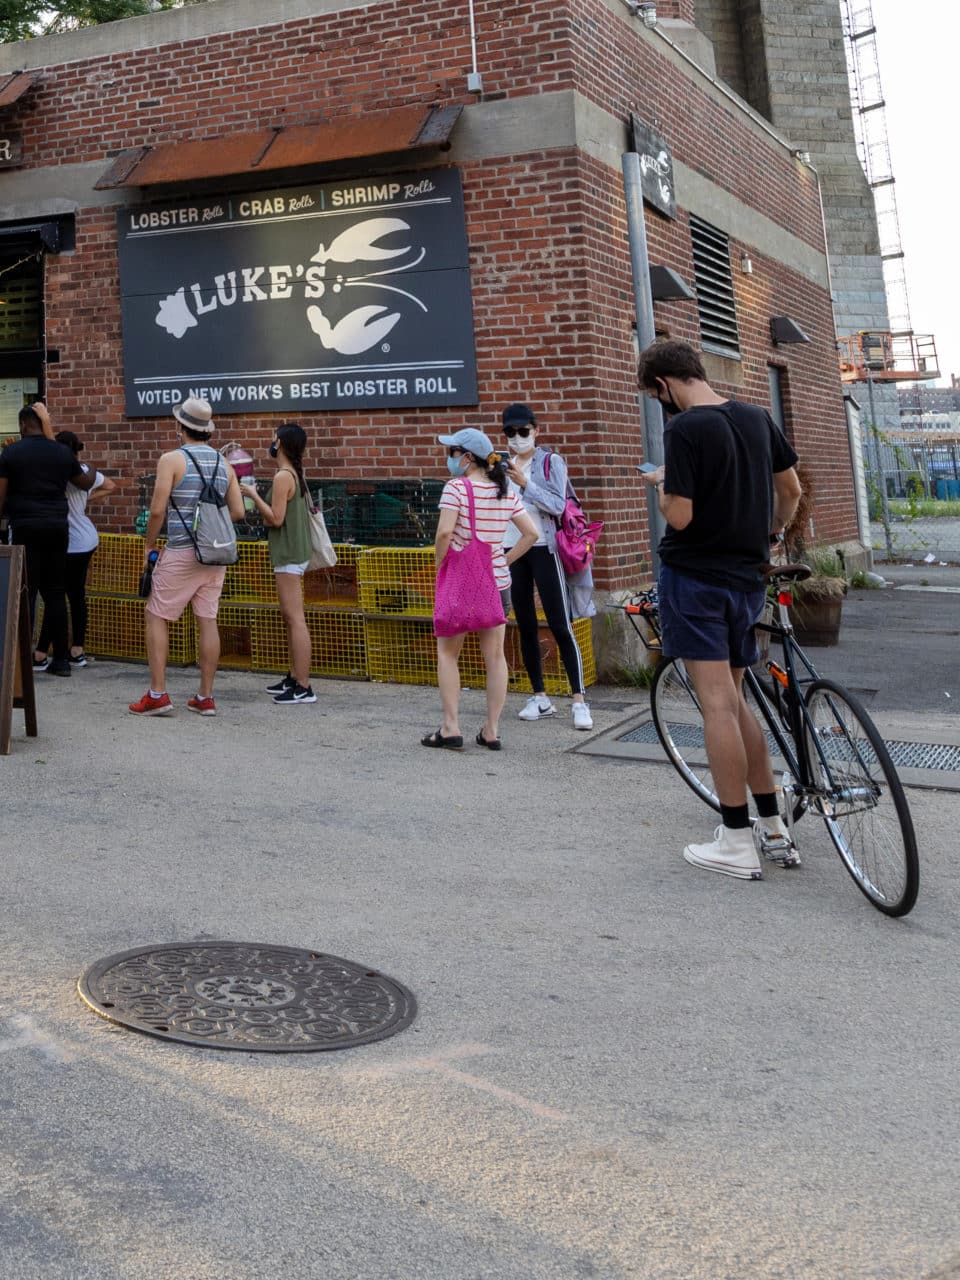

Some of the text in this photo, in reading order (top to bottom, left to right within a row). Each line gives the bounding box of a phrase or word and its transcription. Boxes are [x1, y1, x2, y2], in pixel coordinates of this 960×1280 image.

[240, 195, 315, 216] CRAB Rolls
[331, 179, 436, 207] SHRIMP Rolls
[131, 205, 224, 230] LOBSTER Rolls
[190, 264, 326, 315] LUKE'S
[137, 376, 457, 405] VOTED NEW YORK'S BEST LOBSTER ROLL
